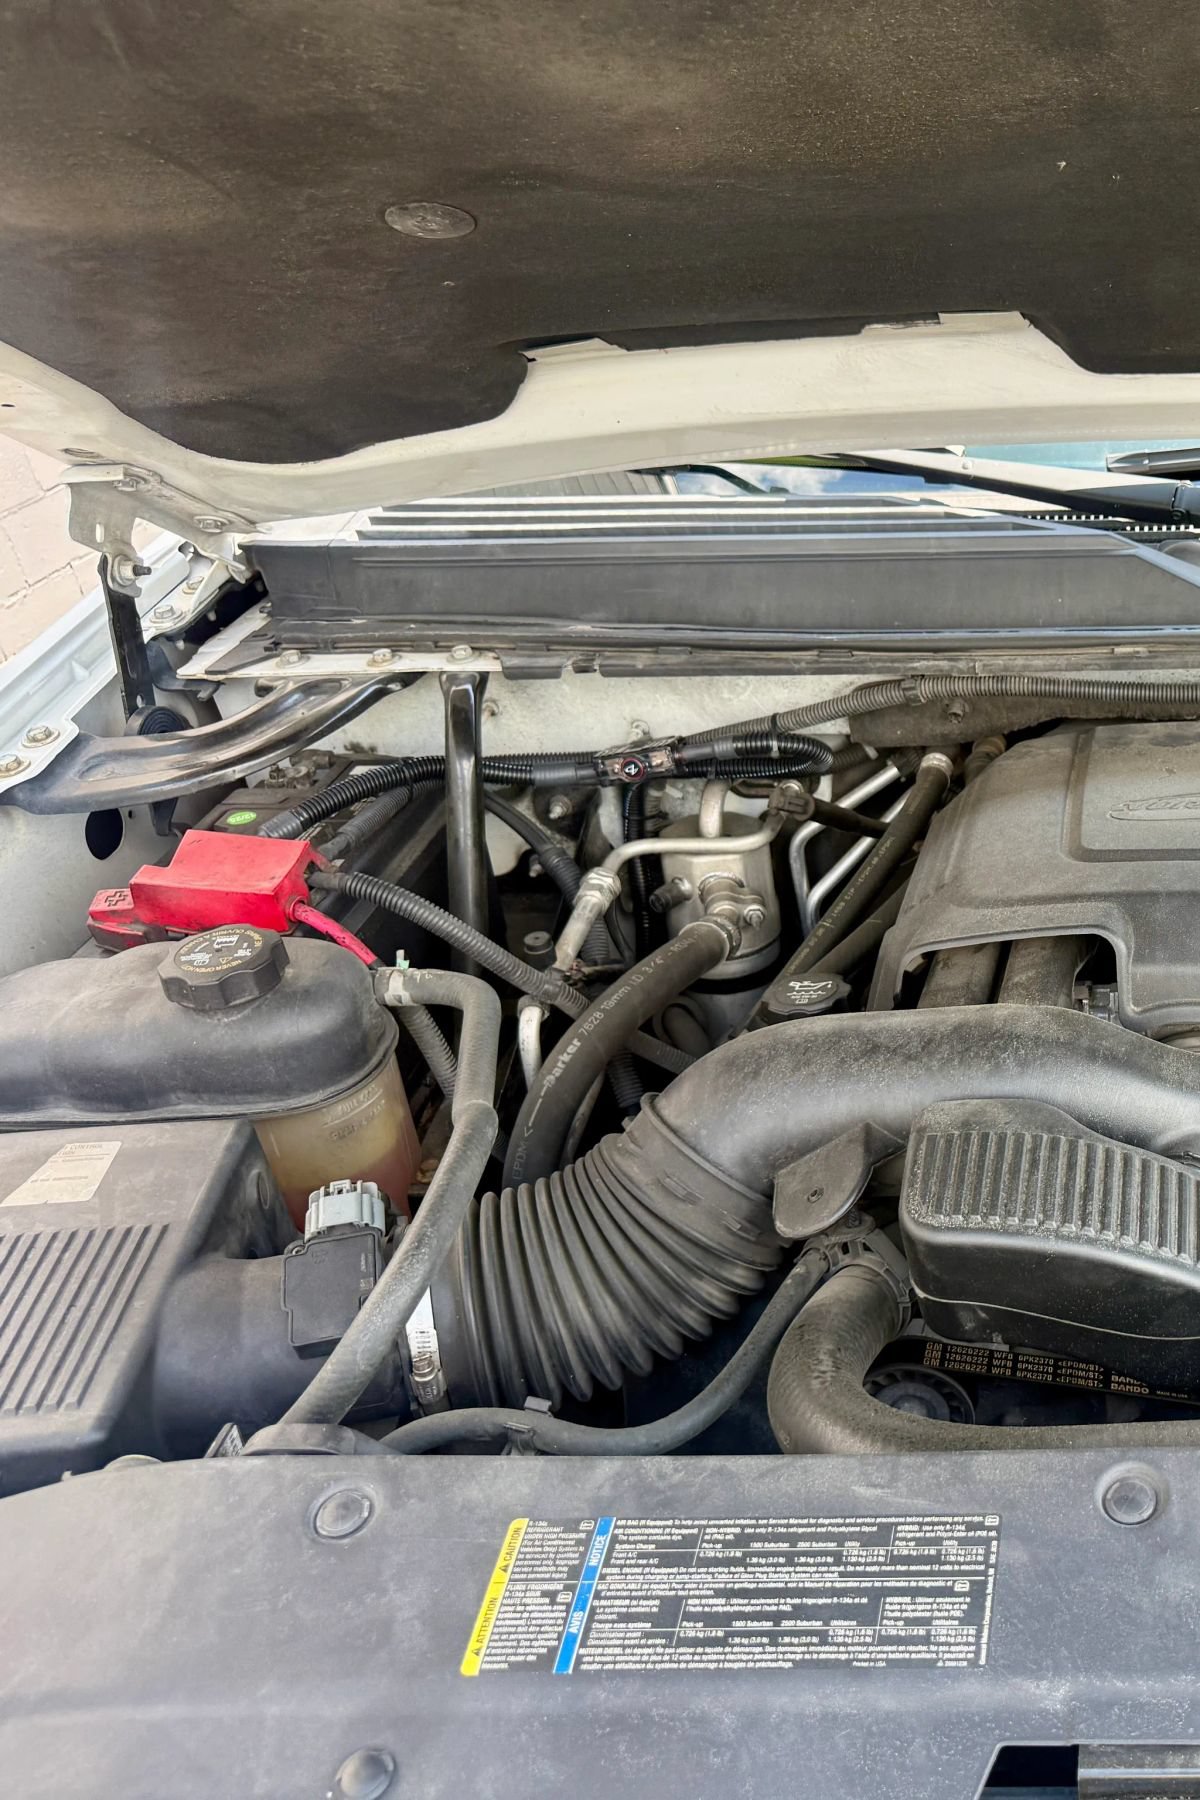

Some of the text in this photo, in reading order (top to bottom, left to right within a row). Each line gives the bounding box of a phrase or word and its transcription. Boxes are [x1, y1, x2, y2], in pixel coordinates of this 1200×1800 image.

[925, 1350, 941, 1359] GM
[945, 1352, 989, 1364] 12626222
[1017, 1362, 1053, 1373] 6PK2370
[1111, 1375, 1147, 1386] BAN
[926, 1342, 942, 1350] GM
[946, 1345, 990, 1357] 12626222
[1018, 1354, 1054, 1365] 6PK2370
[923, 1358, 940, 1367] GM
[944, 1361, 987, 1373] 12626222
[1016, 1370, 1052, 1381] 6PK2370
[1111, 1383, 1149, 1394] BANDO
[503, 1528, 522, 1561] CAUTION
[588, 1534, 608, 1567] NOTICE
[476, 1597, 498, 1643] ATTENTION
[568, 1611, 584, 1634] AVIS
